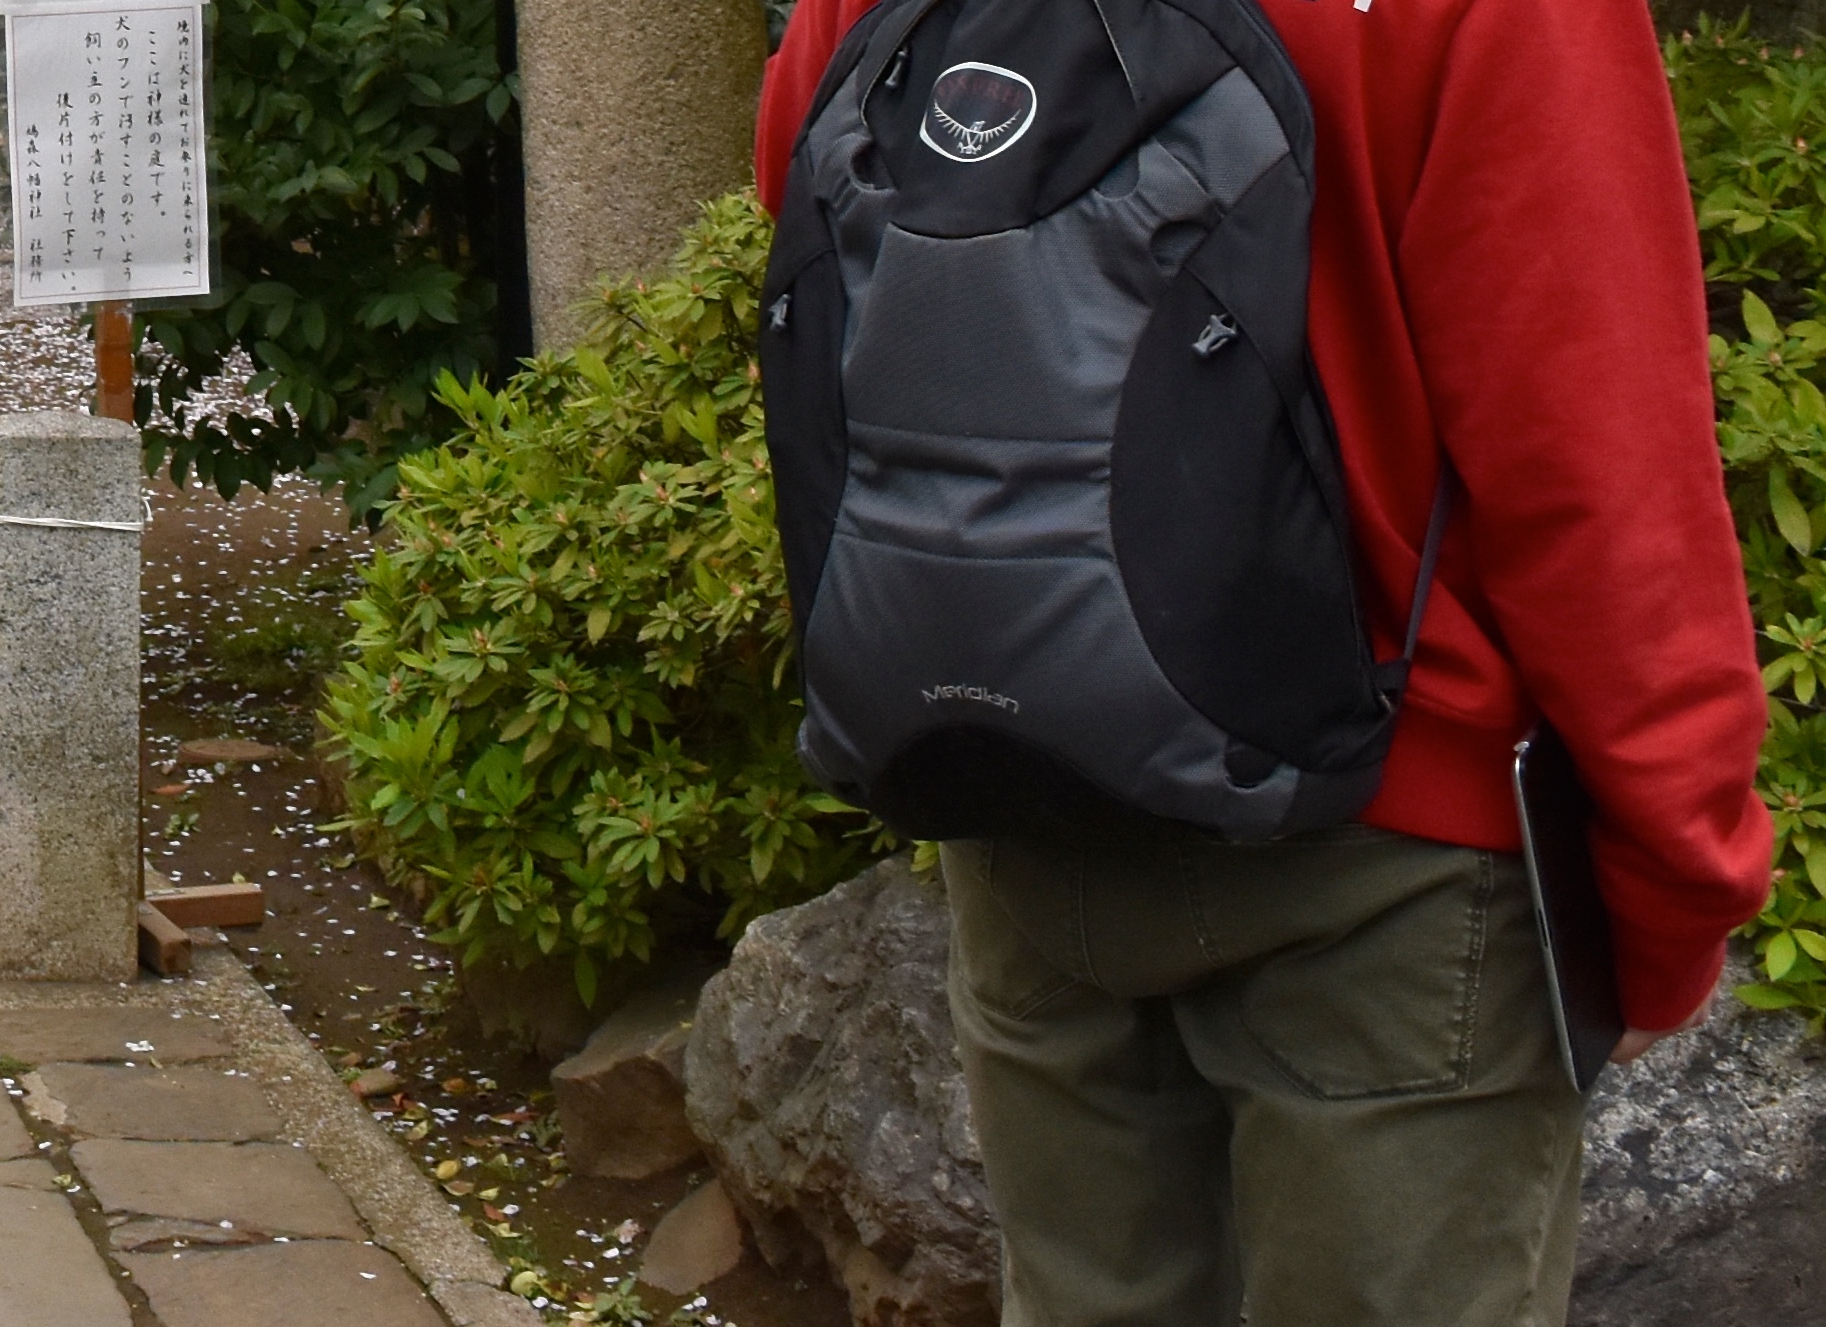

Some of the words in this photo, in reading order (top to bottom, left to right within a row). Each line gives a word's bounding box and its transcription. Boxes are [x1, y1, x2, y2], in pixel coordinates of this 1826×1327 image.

[57, 92, 78, 291] 後片付けをして下さい。
[114, 15, 136, 283] 犬のフンで汚すことのないよう
[146, 30, 166, 217] ここは神様の庭です。
[921, 684, 1020, 714] Meridian
